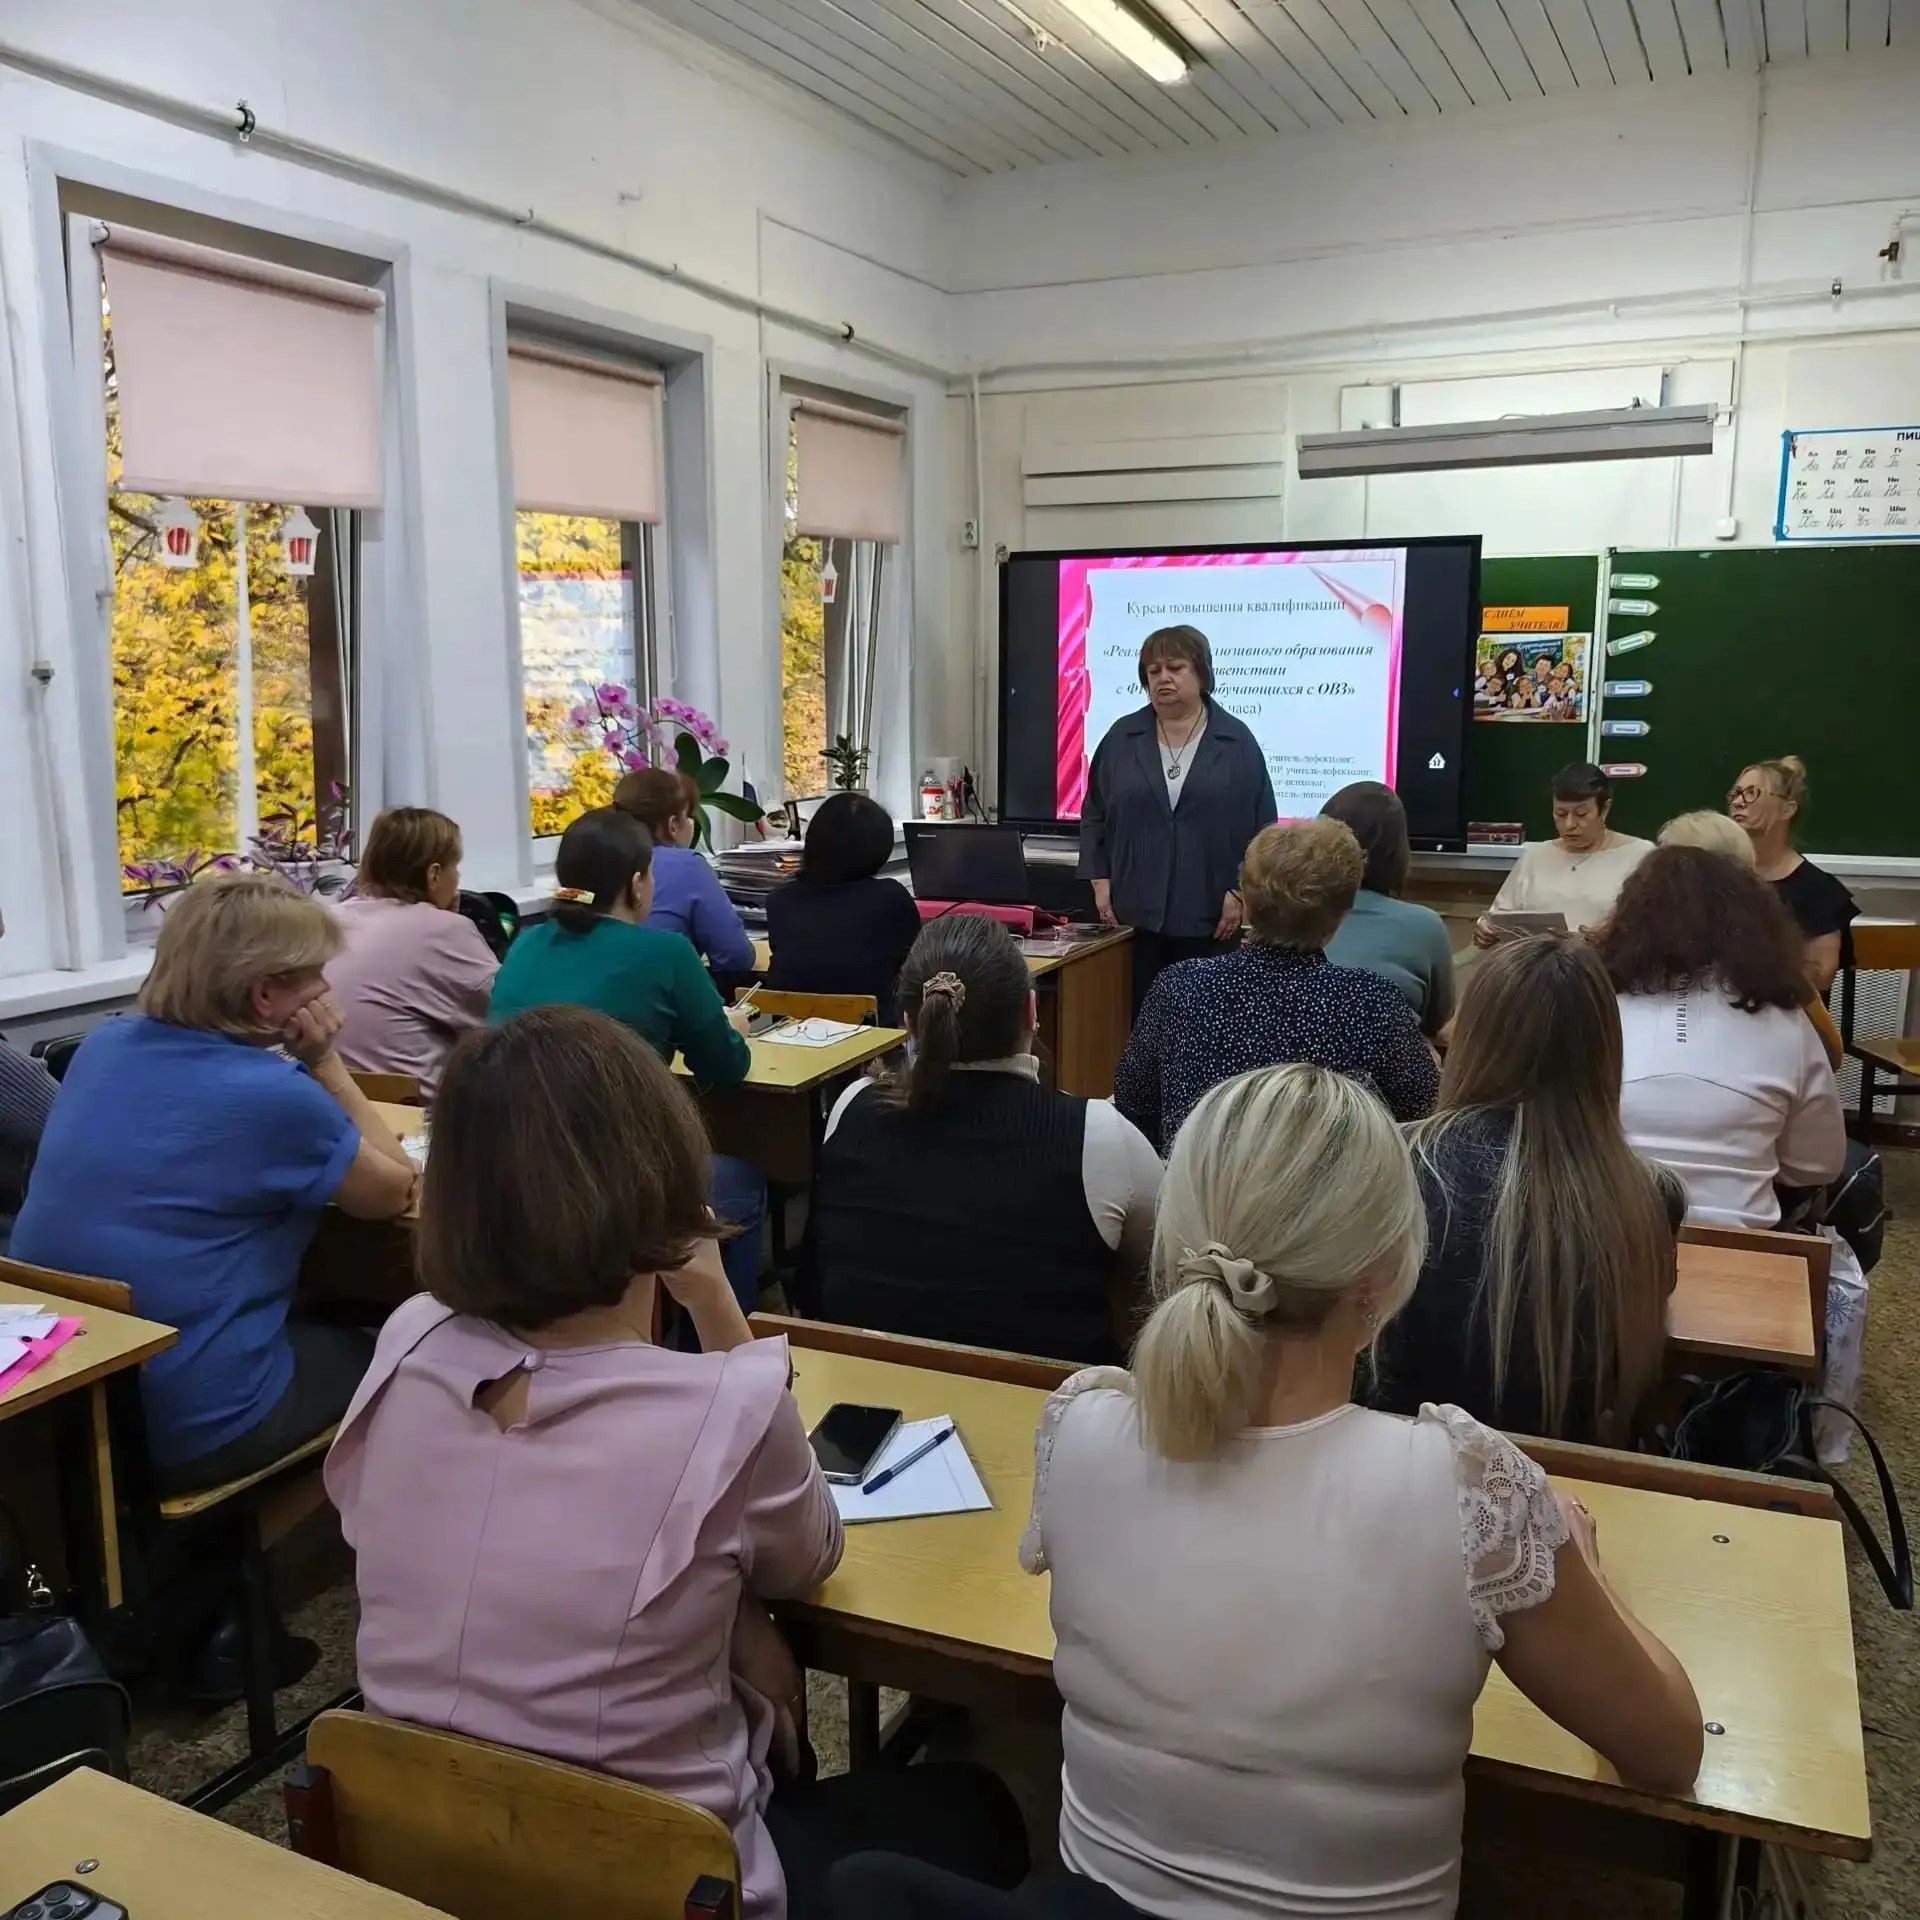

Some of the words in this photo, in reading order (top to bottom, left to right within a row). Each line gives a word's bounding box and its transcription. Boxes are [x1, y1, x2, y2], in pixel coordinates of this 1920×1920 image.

[1127, 601, 1166, 617] Курсы
[1169, 601, 1243, 615] повышения
[1247, 597, 1346, 615] квалификации
[1285, 644, 1374, 659] образования
[1318, 681, 1356, 696] ОВЗ»
[1229, 702, 1262, 715] часа)
